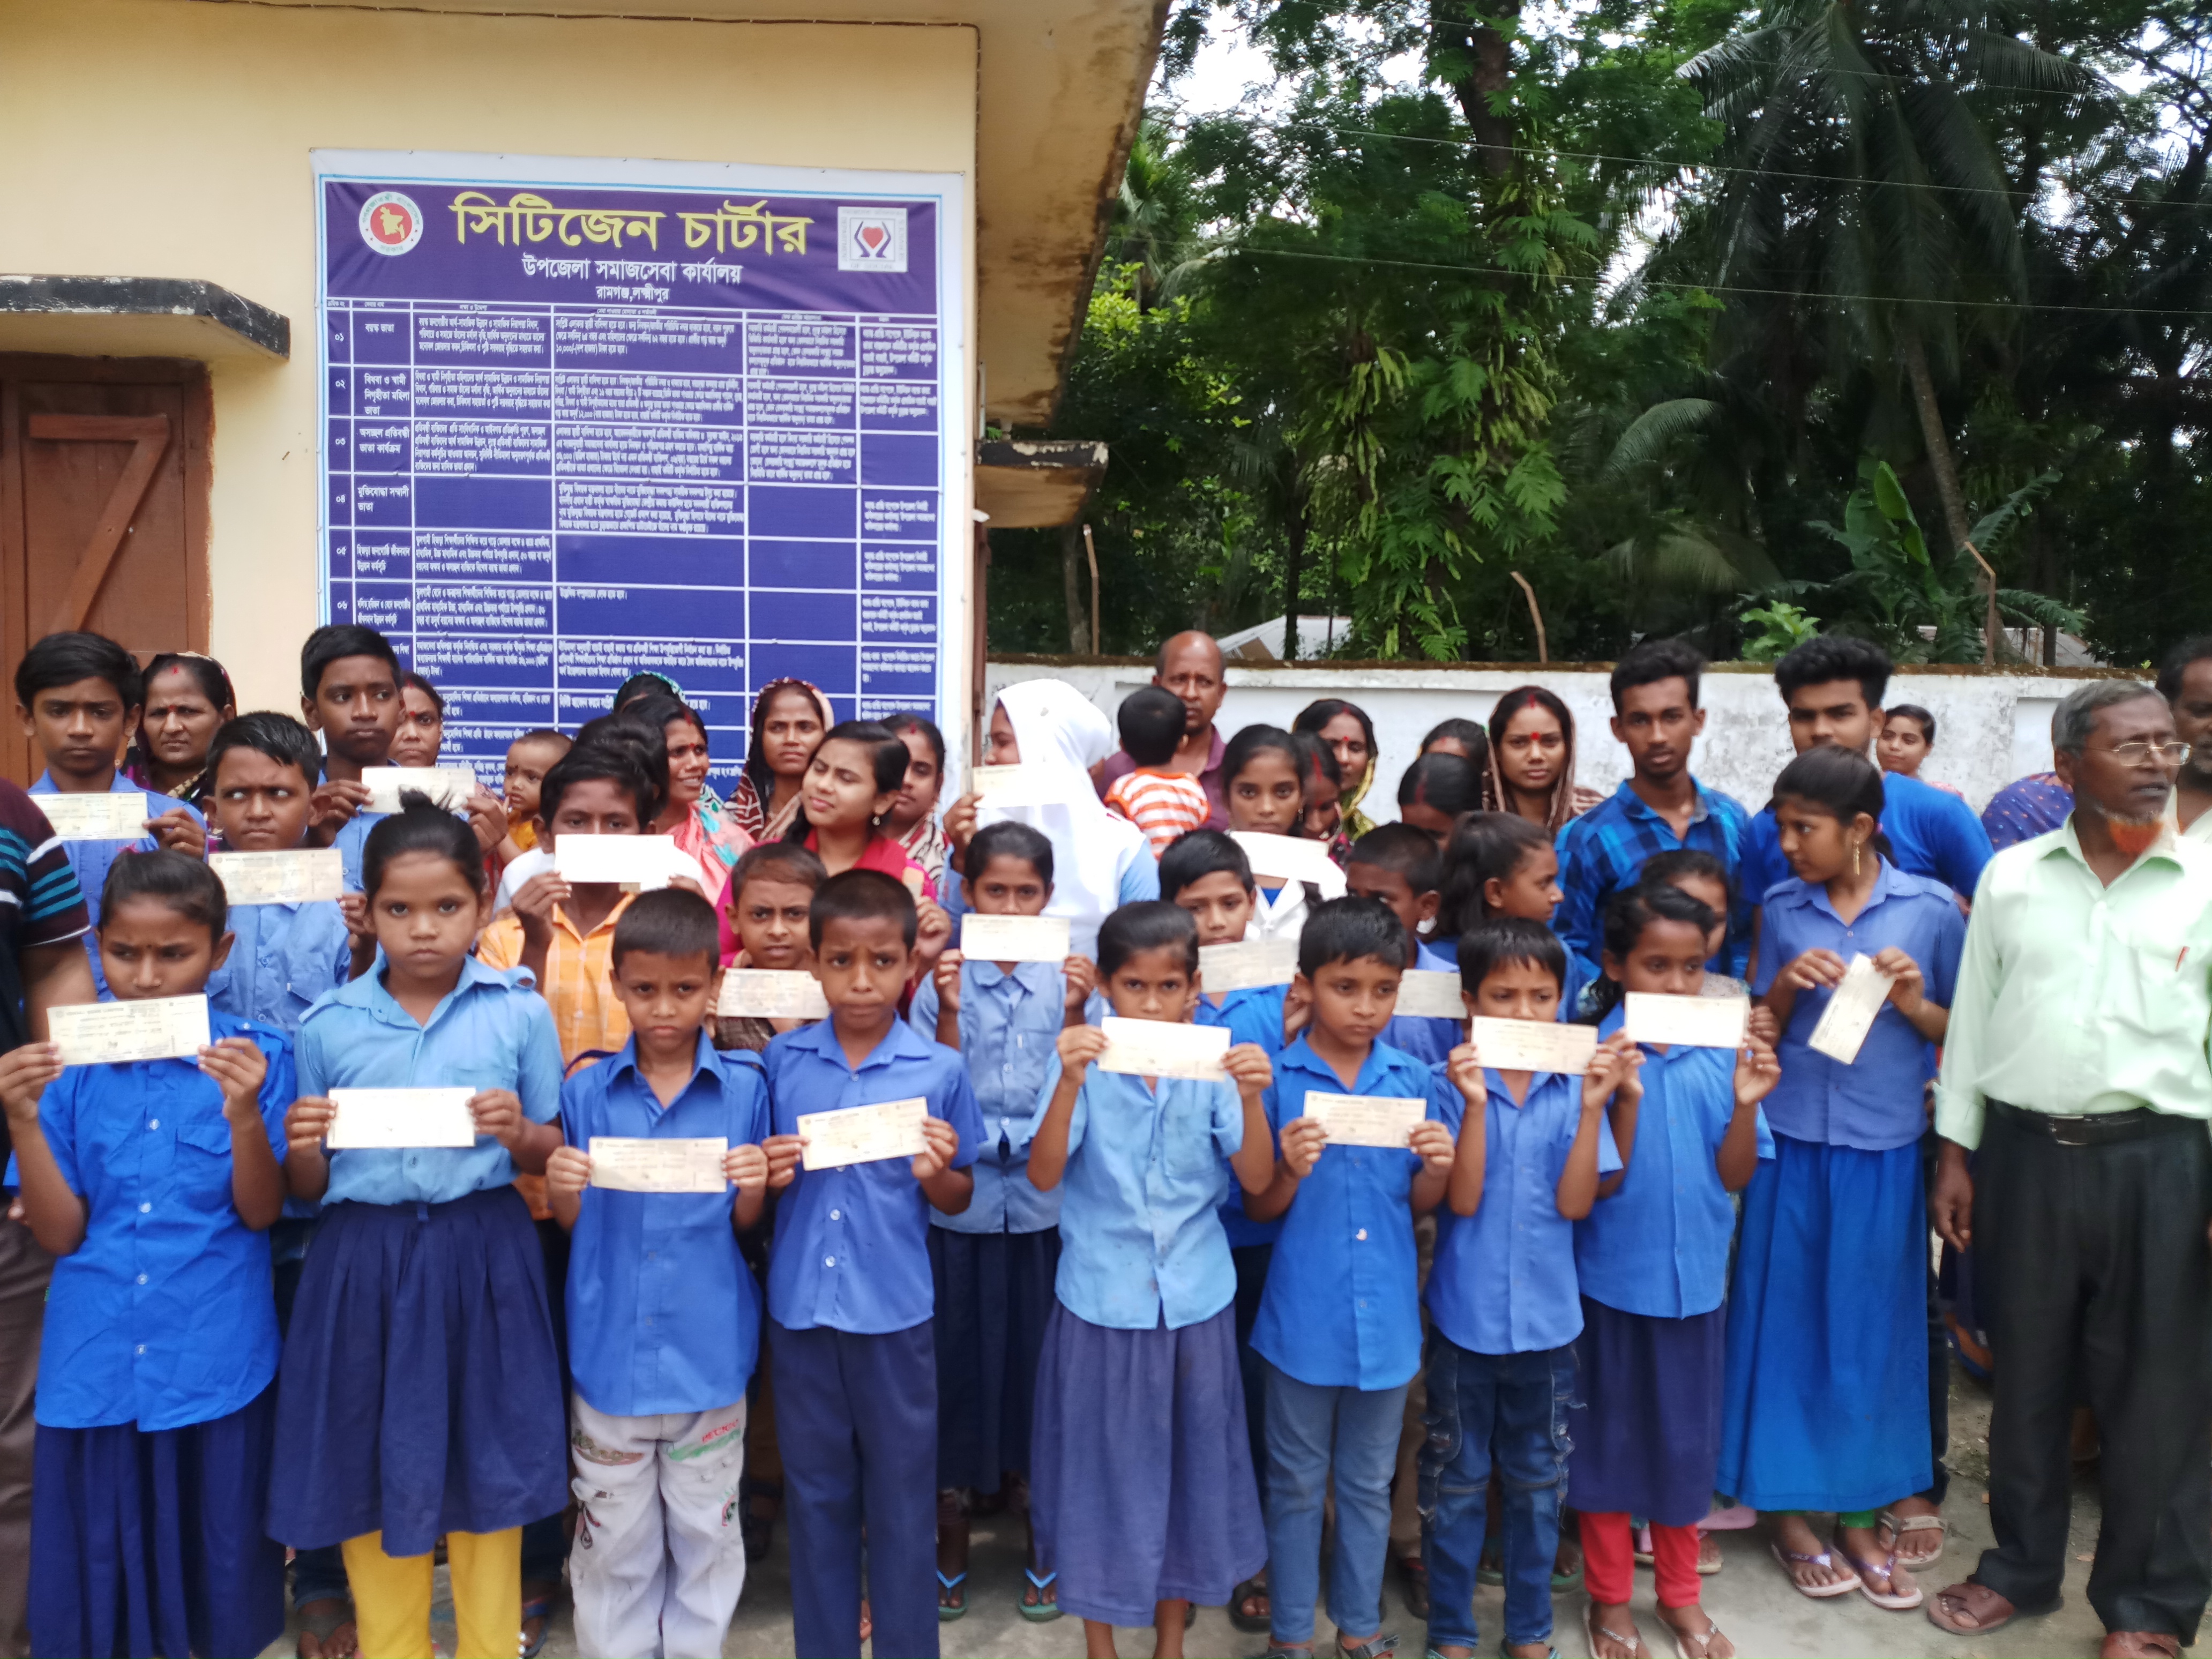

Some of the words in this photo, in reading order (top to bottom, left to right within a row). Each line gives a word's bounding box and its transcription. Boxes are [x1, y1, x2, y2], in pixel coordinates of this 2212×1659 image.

[448, 191, 667, 251] সিটিজেন
[676, 200, 814, 256] চার্টার
[522, 253, 590, 280] উপজেলা
[595, 259, 677, 283] সমাজসেবা
[682, 258, 743, 285] কার্যালয়
[334, 333, 344, 342] ০১
[335, 379, 346, 389] ০২
[364, 372, 382, 385] বিধবা
[384, 376, 390, 385] ও
[392, 373, 406, 386] স্বামী
[392, 390, 409, 402] মহিলা
[364, 406, 380, 416] ভাতা
[360, 444, 375, 453] ভাতা
[377, 441, 401, 454] কার্যক্রম
[336, 494, 345, 503] ০৪
[358, 503, 373, 512] ভাতা
